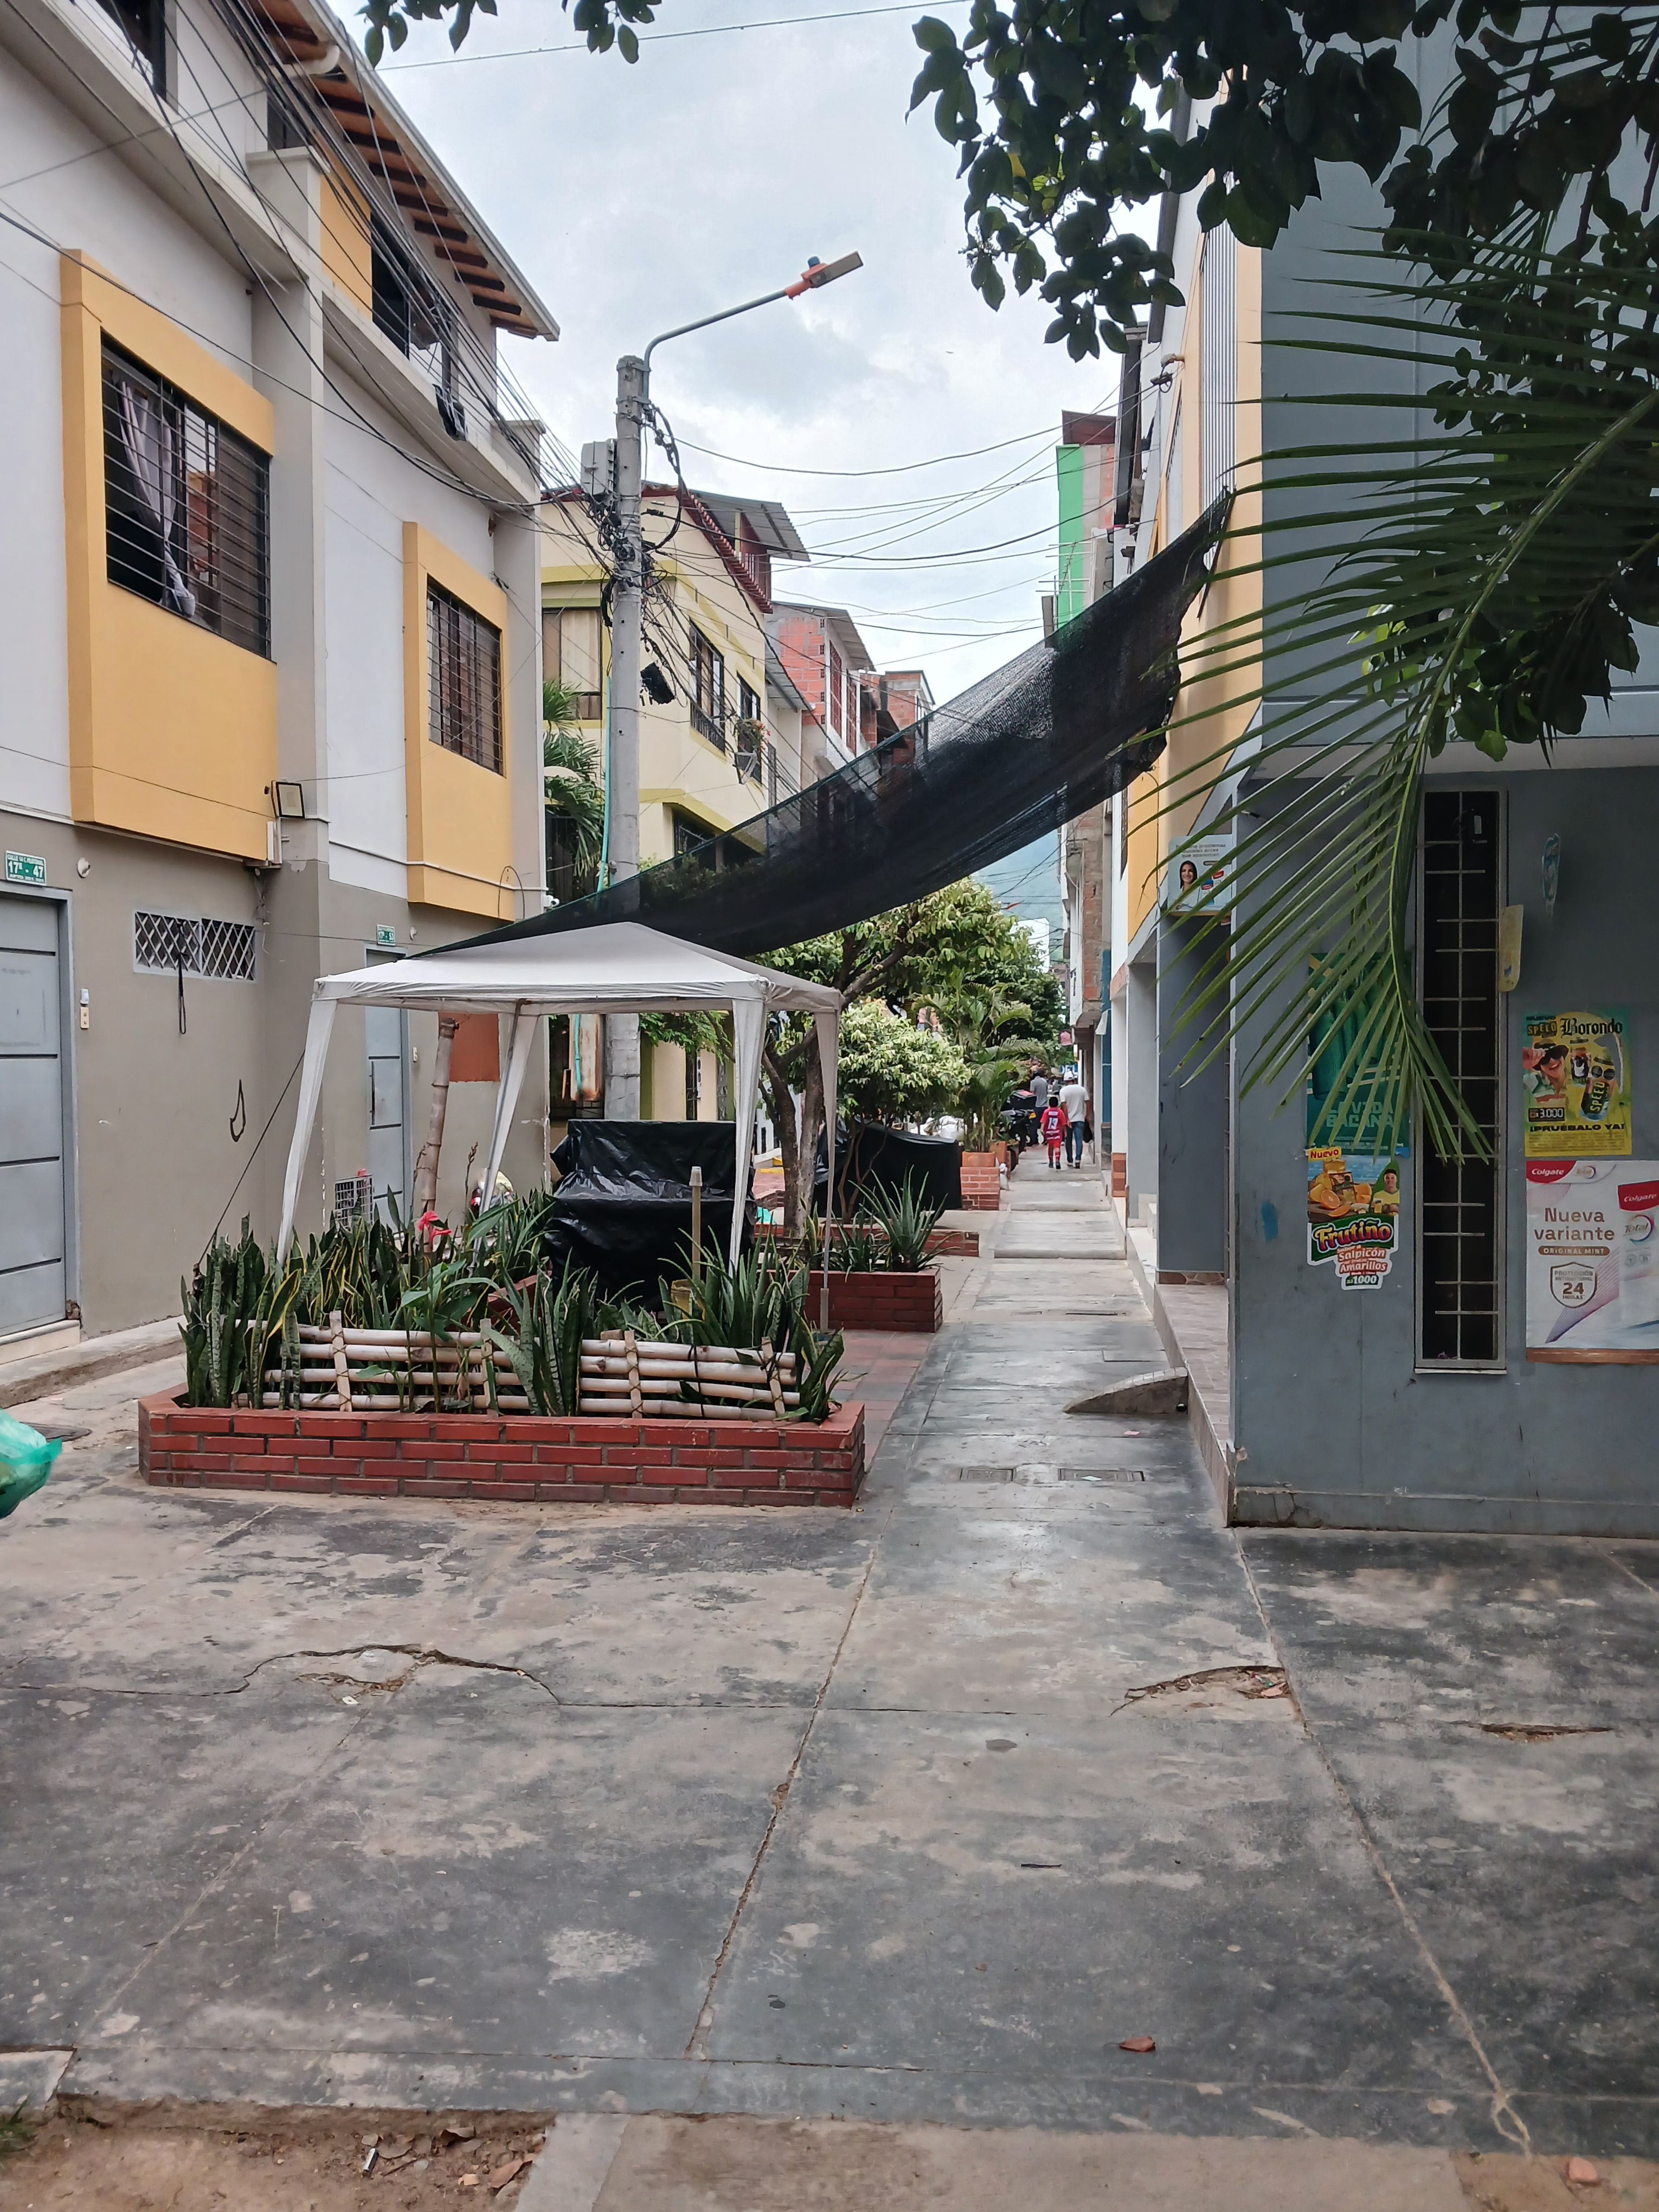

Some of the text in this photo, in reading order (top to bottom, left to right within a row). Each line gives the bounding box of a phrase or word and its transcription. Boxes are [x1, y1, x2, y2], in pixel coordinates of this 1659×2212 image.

[33, 865, 44, 878] 47
[1527, 1023, 1556, 1035] SPEED
[1559, 1017, 1623, 1039] Borondo
[1590, 1082, 1605, 1112] SPEED
[1310, 1149, 1339, 1159] Nuevo
[1532, 1168, 1564, 1176] Colgate
[1624, 1193, 1657, 1203] Colgate
[1545, 1207, 1605, 1223] Nueva
[1534, 1226, 1615, 1241] variante
[1624, 1223, 1649, 1233] Total
[1314, 1220, 1392, 1252] Frutiño
[1339, 1248, 1385, 1262] Salpicón
[1340, 1261, 1387, 1273] Amarillos
[1562, 1282, 1584, 1295] 24
